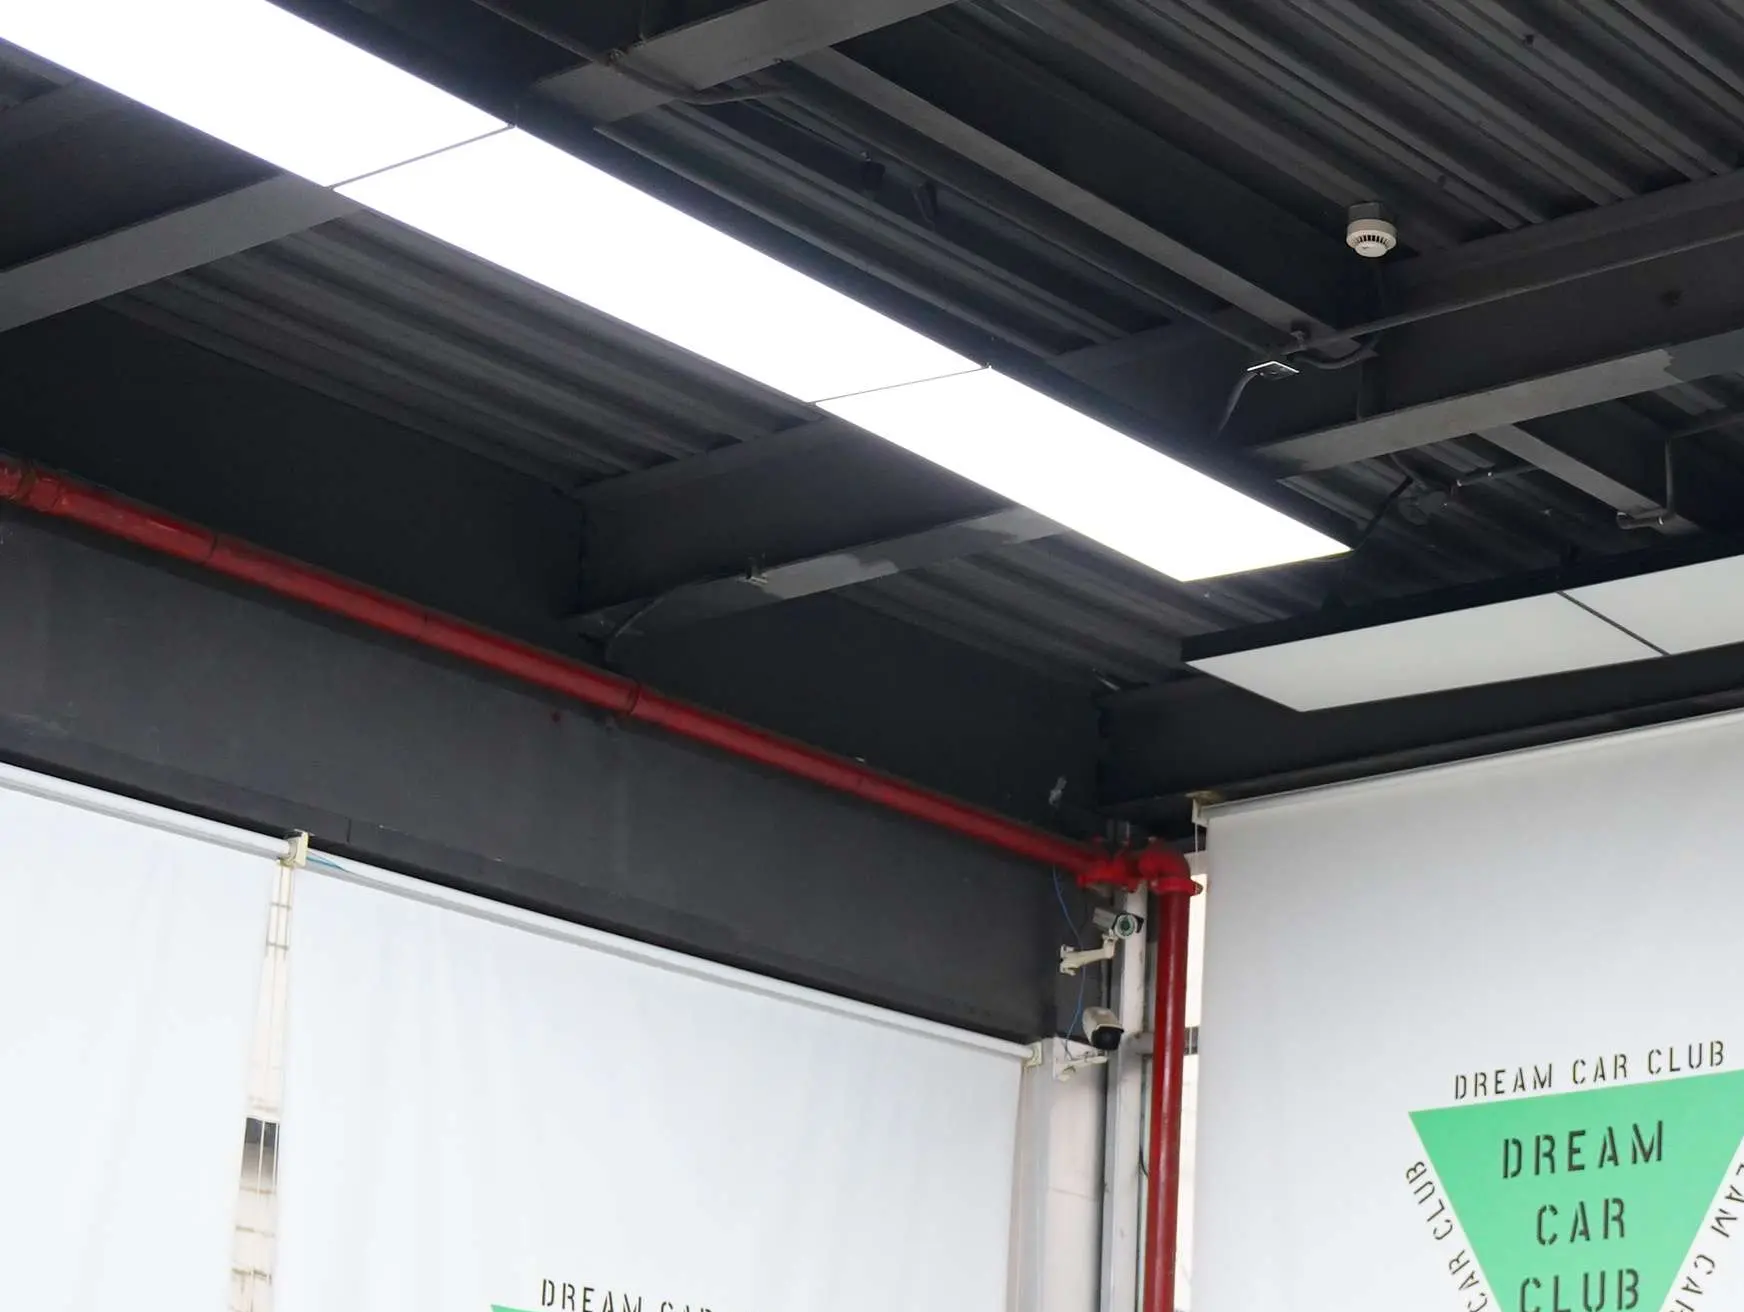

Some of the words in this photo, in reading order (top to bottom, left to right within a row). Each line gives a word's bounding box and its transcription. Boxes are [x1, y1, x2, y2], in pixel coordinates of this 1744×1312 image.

[1455, 1063, 1553, 1100] DREAM
[1572, 1053, 1627, 1085] CAR
[1648, 1040, 1724, 1075] CLUB
[1502, 1120, 1664, 1179] DREAM
[1406, 1161, 1453, 1241] CLUB
[1536, 1197, 1625, 1246] CAR
